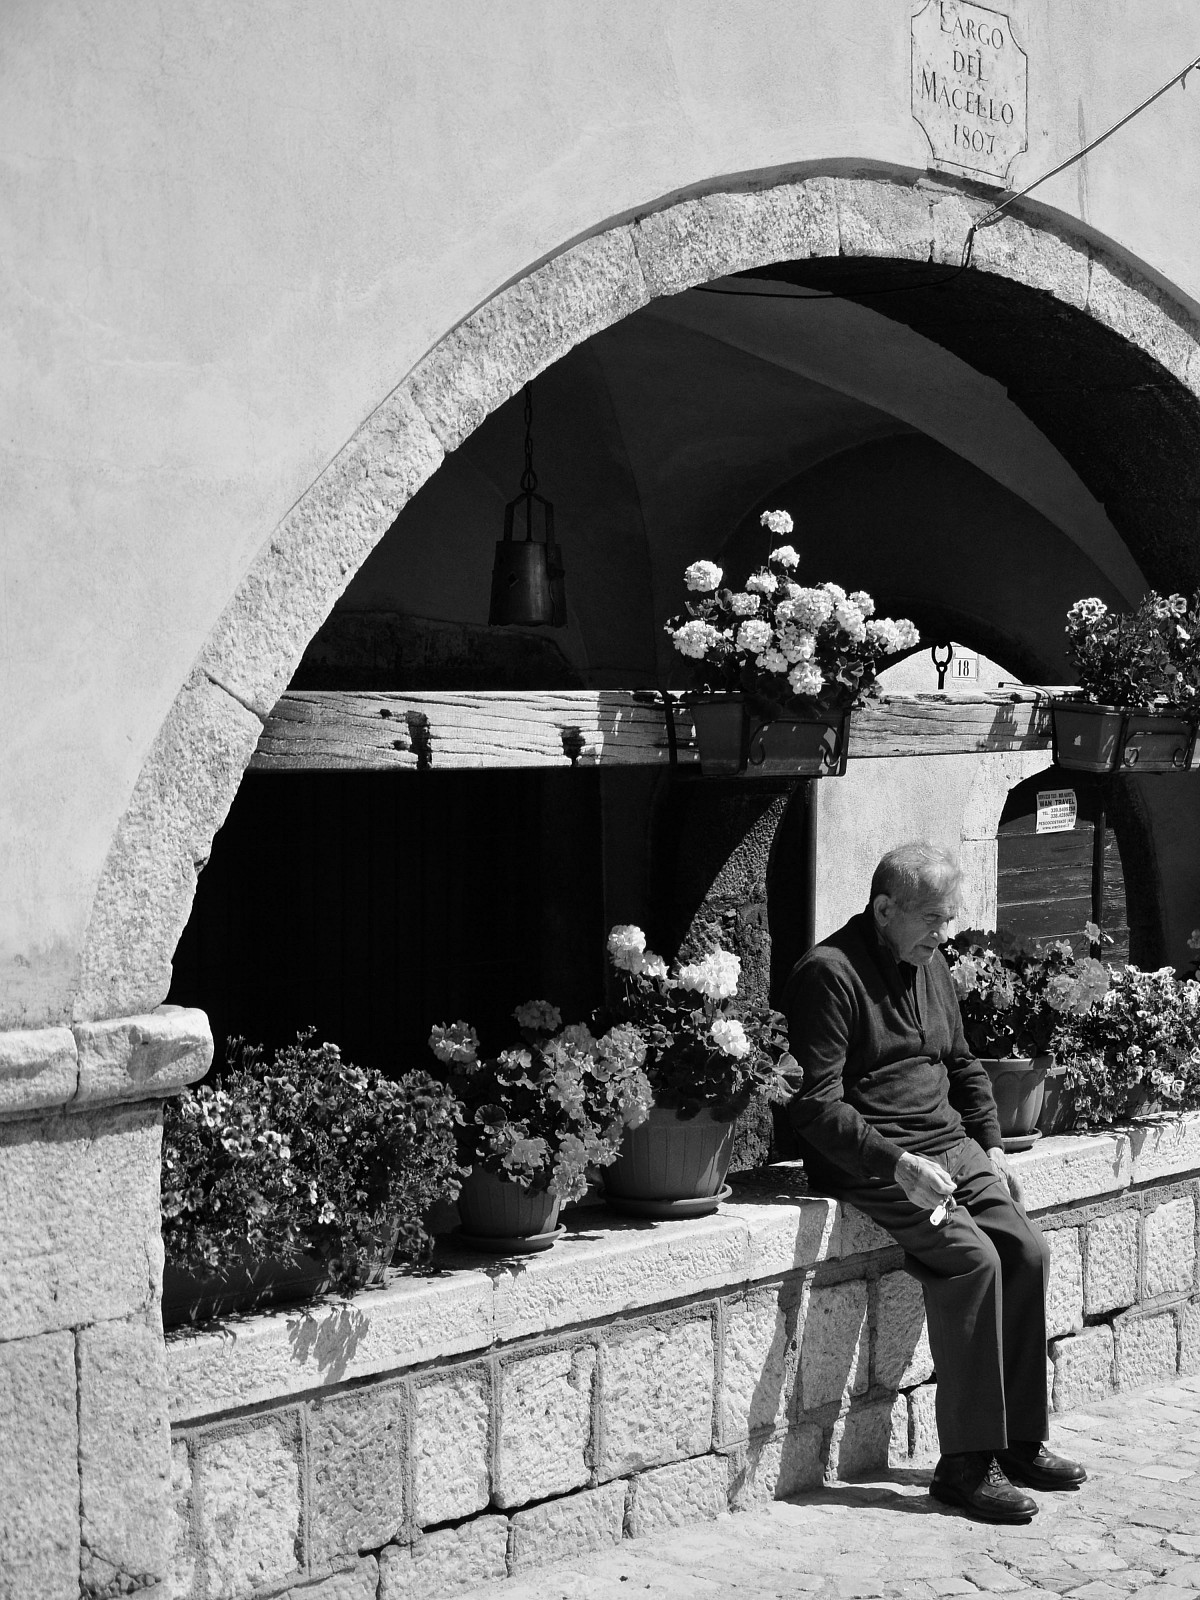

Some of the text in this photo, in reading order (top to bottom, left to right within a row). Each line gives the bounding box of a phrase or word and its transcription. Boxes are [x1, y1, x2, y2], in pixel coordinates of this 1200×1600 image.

[940, 1, 1004, 49] LARGO
[953, 50, 988, 81] DEL
[921, 68, 1014, 125] MACELLO
[954, 124, 995, 155] 1807
[958, 660, 969, 676] 18
[1055, 798, 1075, 806] TRAVEL
